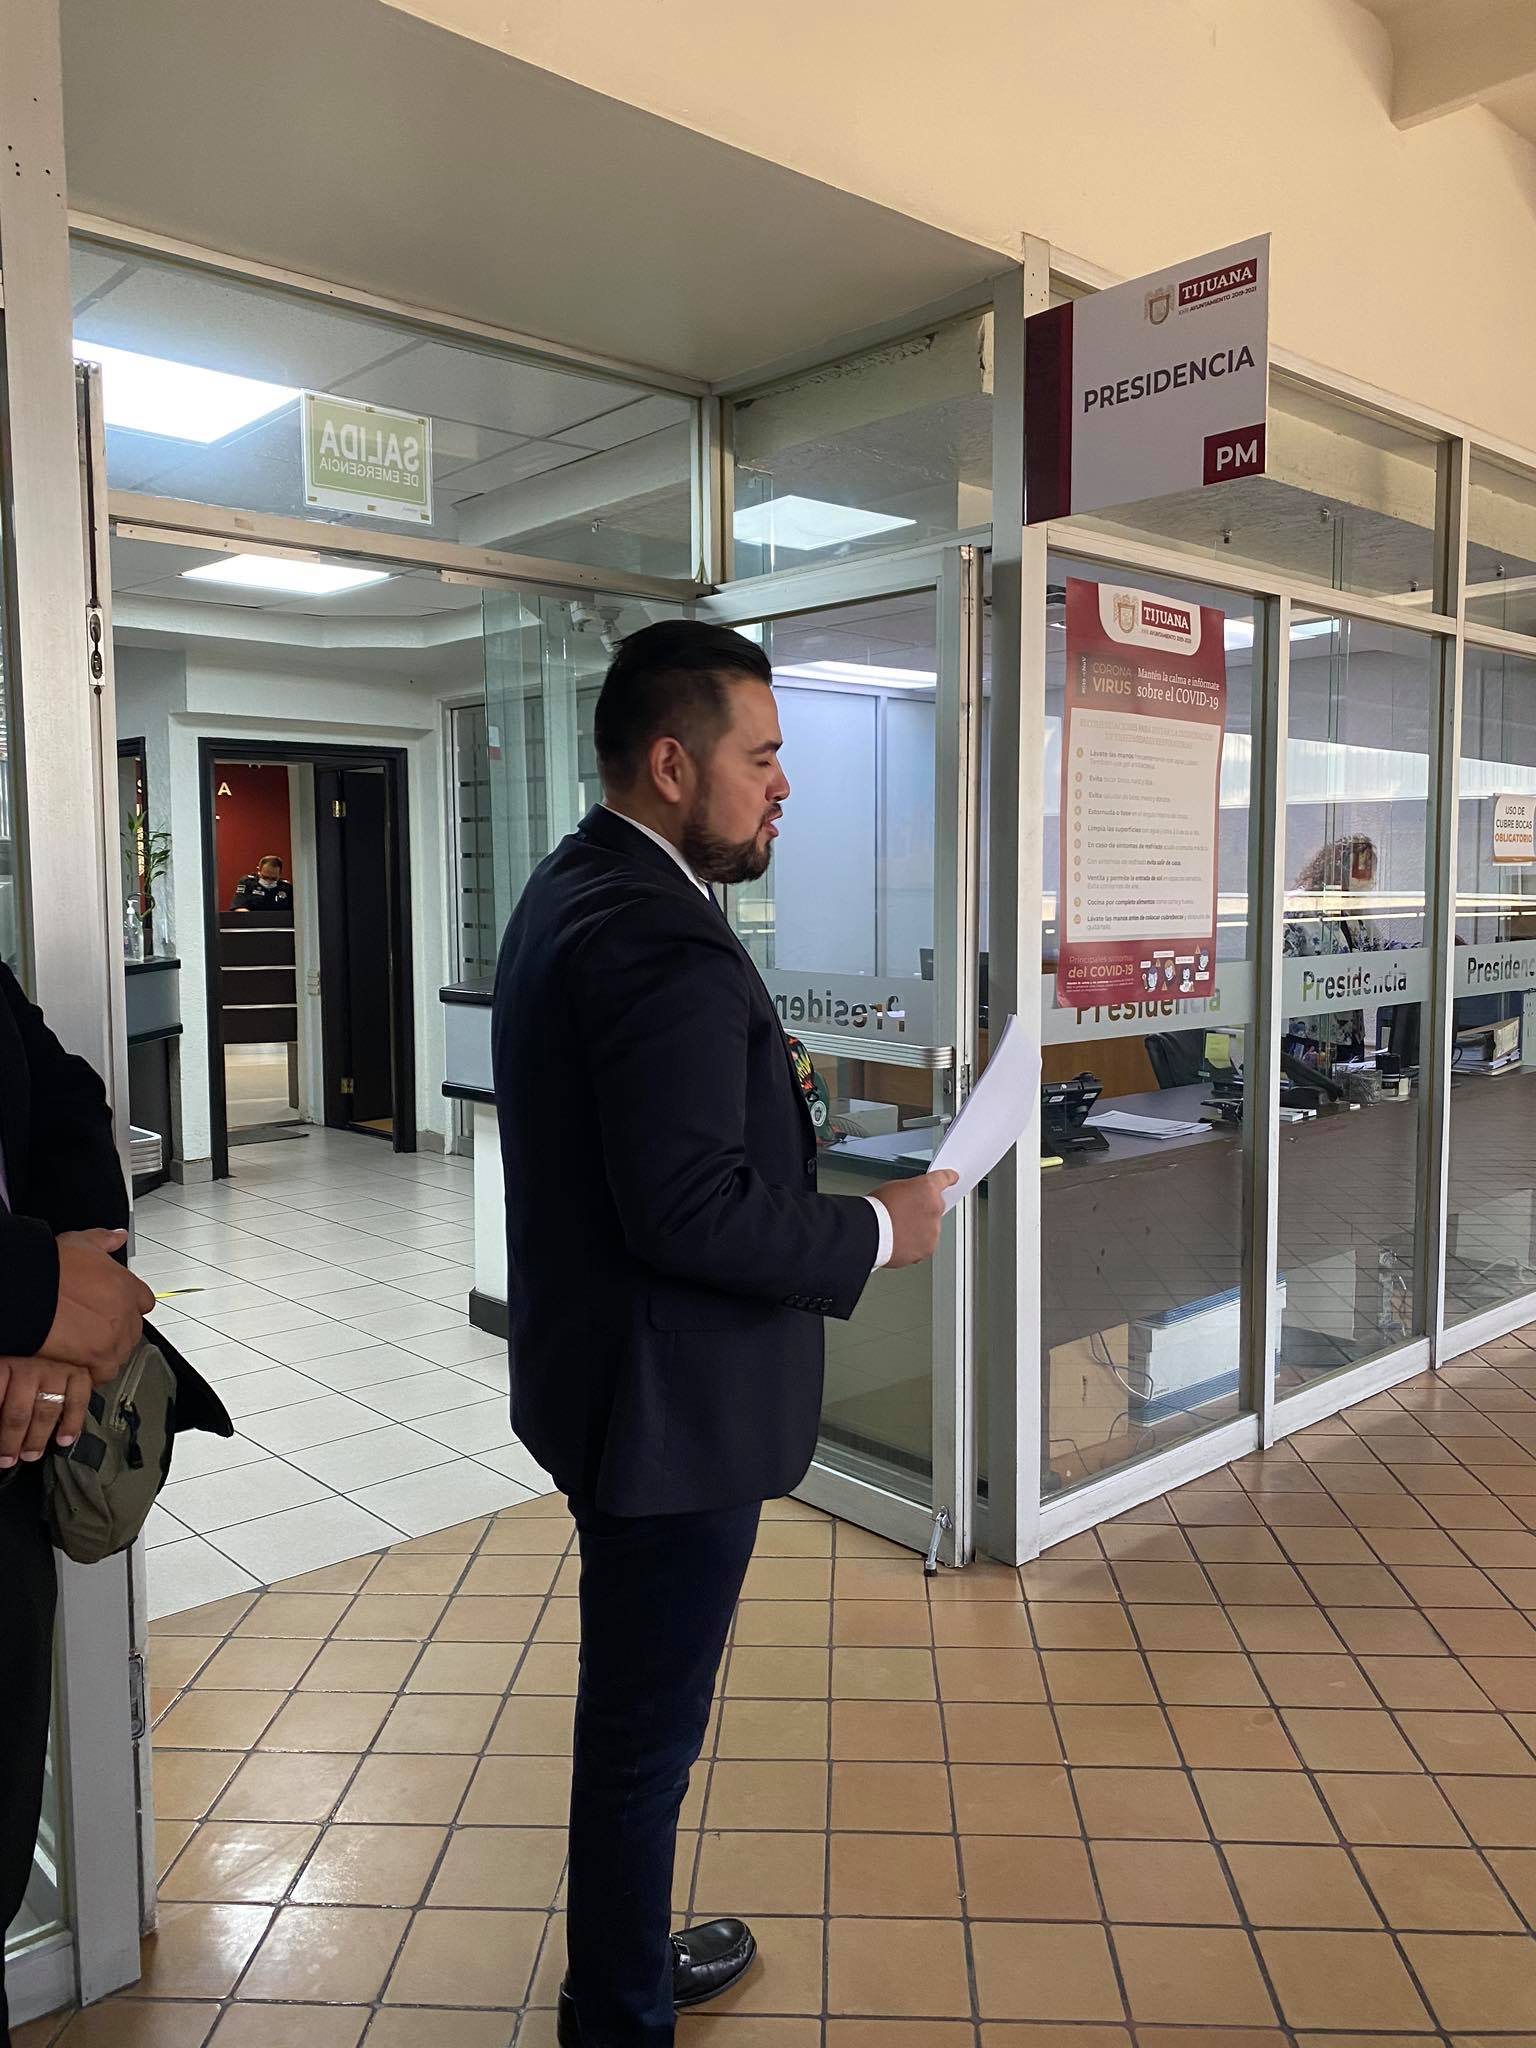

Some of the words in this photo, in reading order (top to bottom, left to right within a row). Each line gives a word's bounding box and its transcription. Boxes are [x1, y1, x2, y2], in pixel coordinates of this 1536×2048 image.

[1182, 266, 1253, 299] TIJUANA
[1083, 345, 1255, 413] PRESIDENCIA
[1216, 439, 1258, 471] PM
[1144, 606, 1189, 630] TIJUANA
[1093, 662, 1131, 676] CORONA
[1162, 672, 1168, 682] la
[1169, 674, 1186, 685] calma
[1093, 677, 1131, 695] VIRUS
[1137, 683, 1163, 700] sobre
[1165, 687, 1174, 701] el
[1176, 688, 1219, 710] COVID-19
[217, 782, 232, 796] A
[1505, 805, 1517, 815] USO
[1517, 806, 1525, 815] DE
[1496, 819, 1514, 828] CUBRE
[1515, 820, 1532, 829] BOCAS
[1495, 833, 1532, 843] OBLIGATORIO
[1068, 966, 1087, 978] del
[1090, 964, 1134, 978] COVID-19
